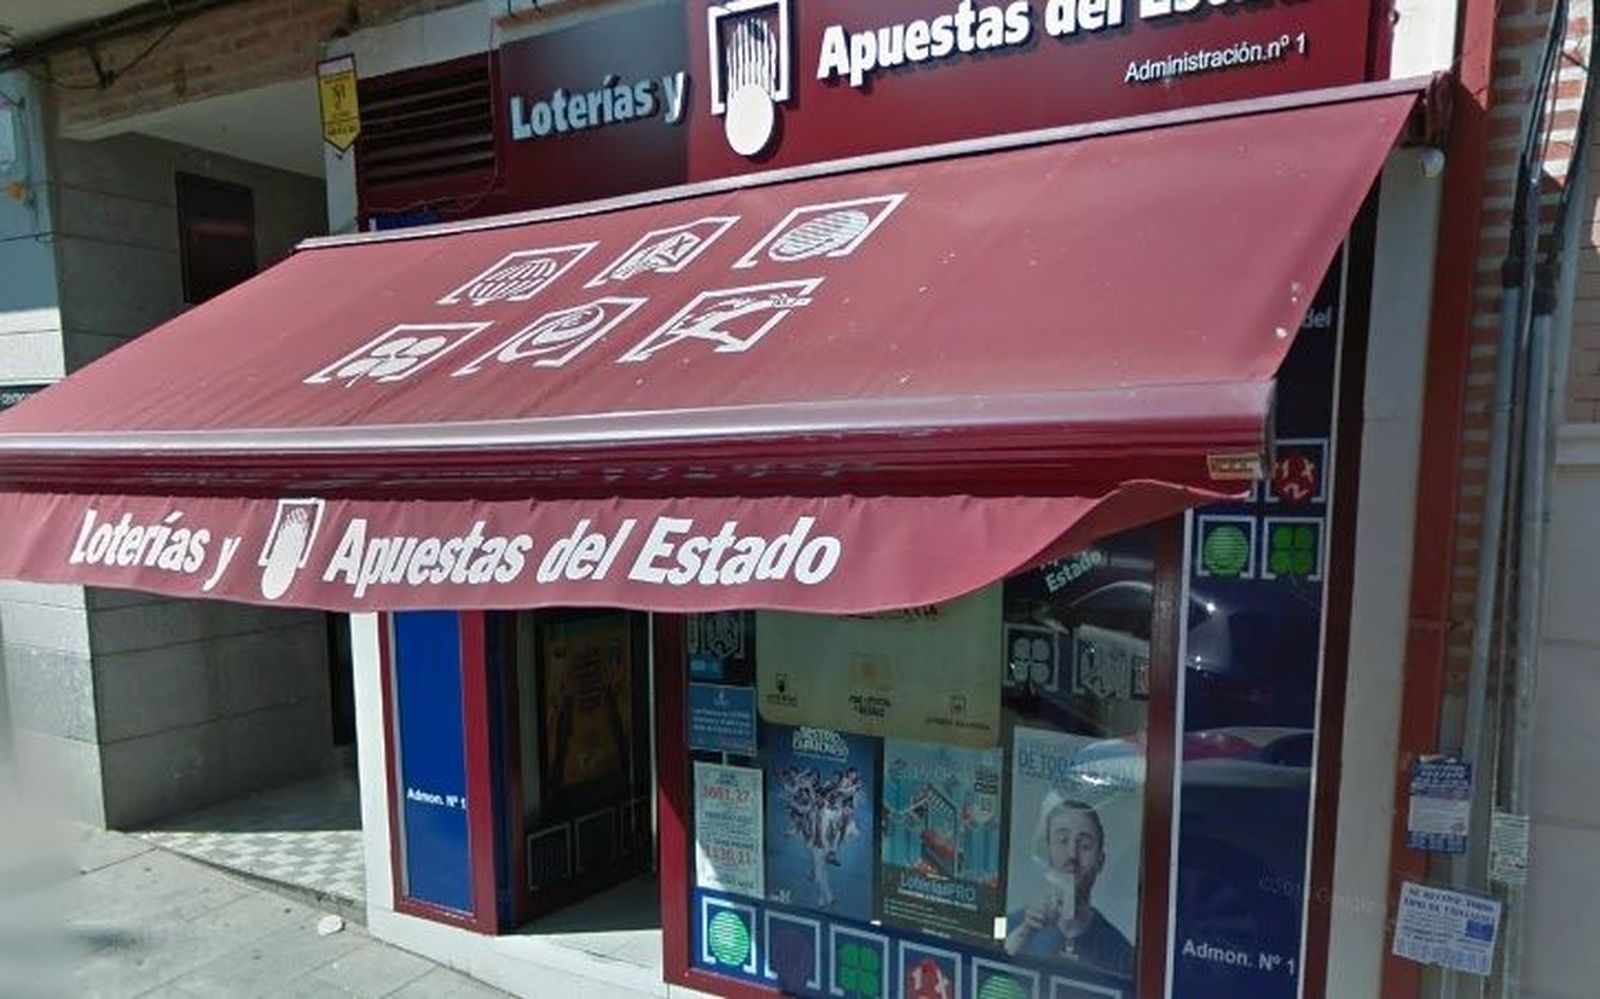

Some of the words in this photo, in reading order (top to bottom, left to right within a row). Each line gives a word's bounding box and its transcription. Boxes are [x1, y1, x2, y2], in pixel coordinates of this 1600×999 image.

[1296, 32, 1305, 53] 1
[510, 74, 653, 140] Loterías
[662, 71, 686, 123] y
[816, 0, 1030, 87] Apuestas
[68, 509, 211, 573] Loterías
[202, 536, 242, 591] y
[322, 518, 534, 598] Apuestas
[536, 518, 637, 583] del
[628, 516, 841, 584] Estado
[1045, 548, 1103, 593] Estado
[1181, 939, 1253, 969] Admon.
[1258, 952, 1281, 972] Nº
[1286, 957, 1296, 977] 1
